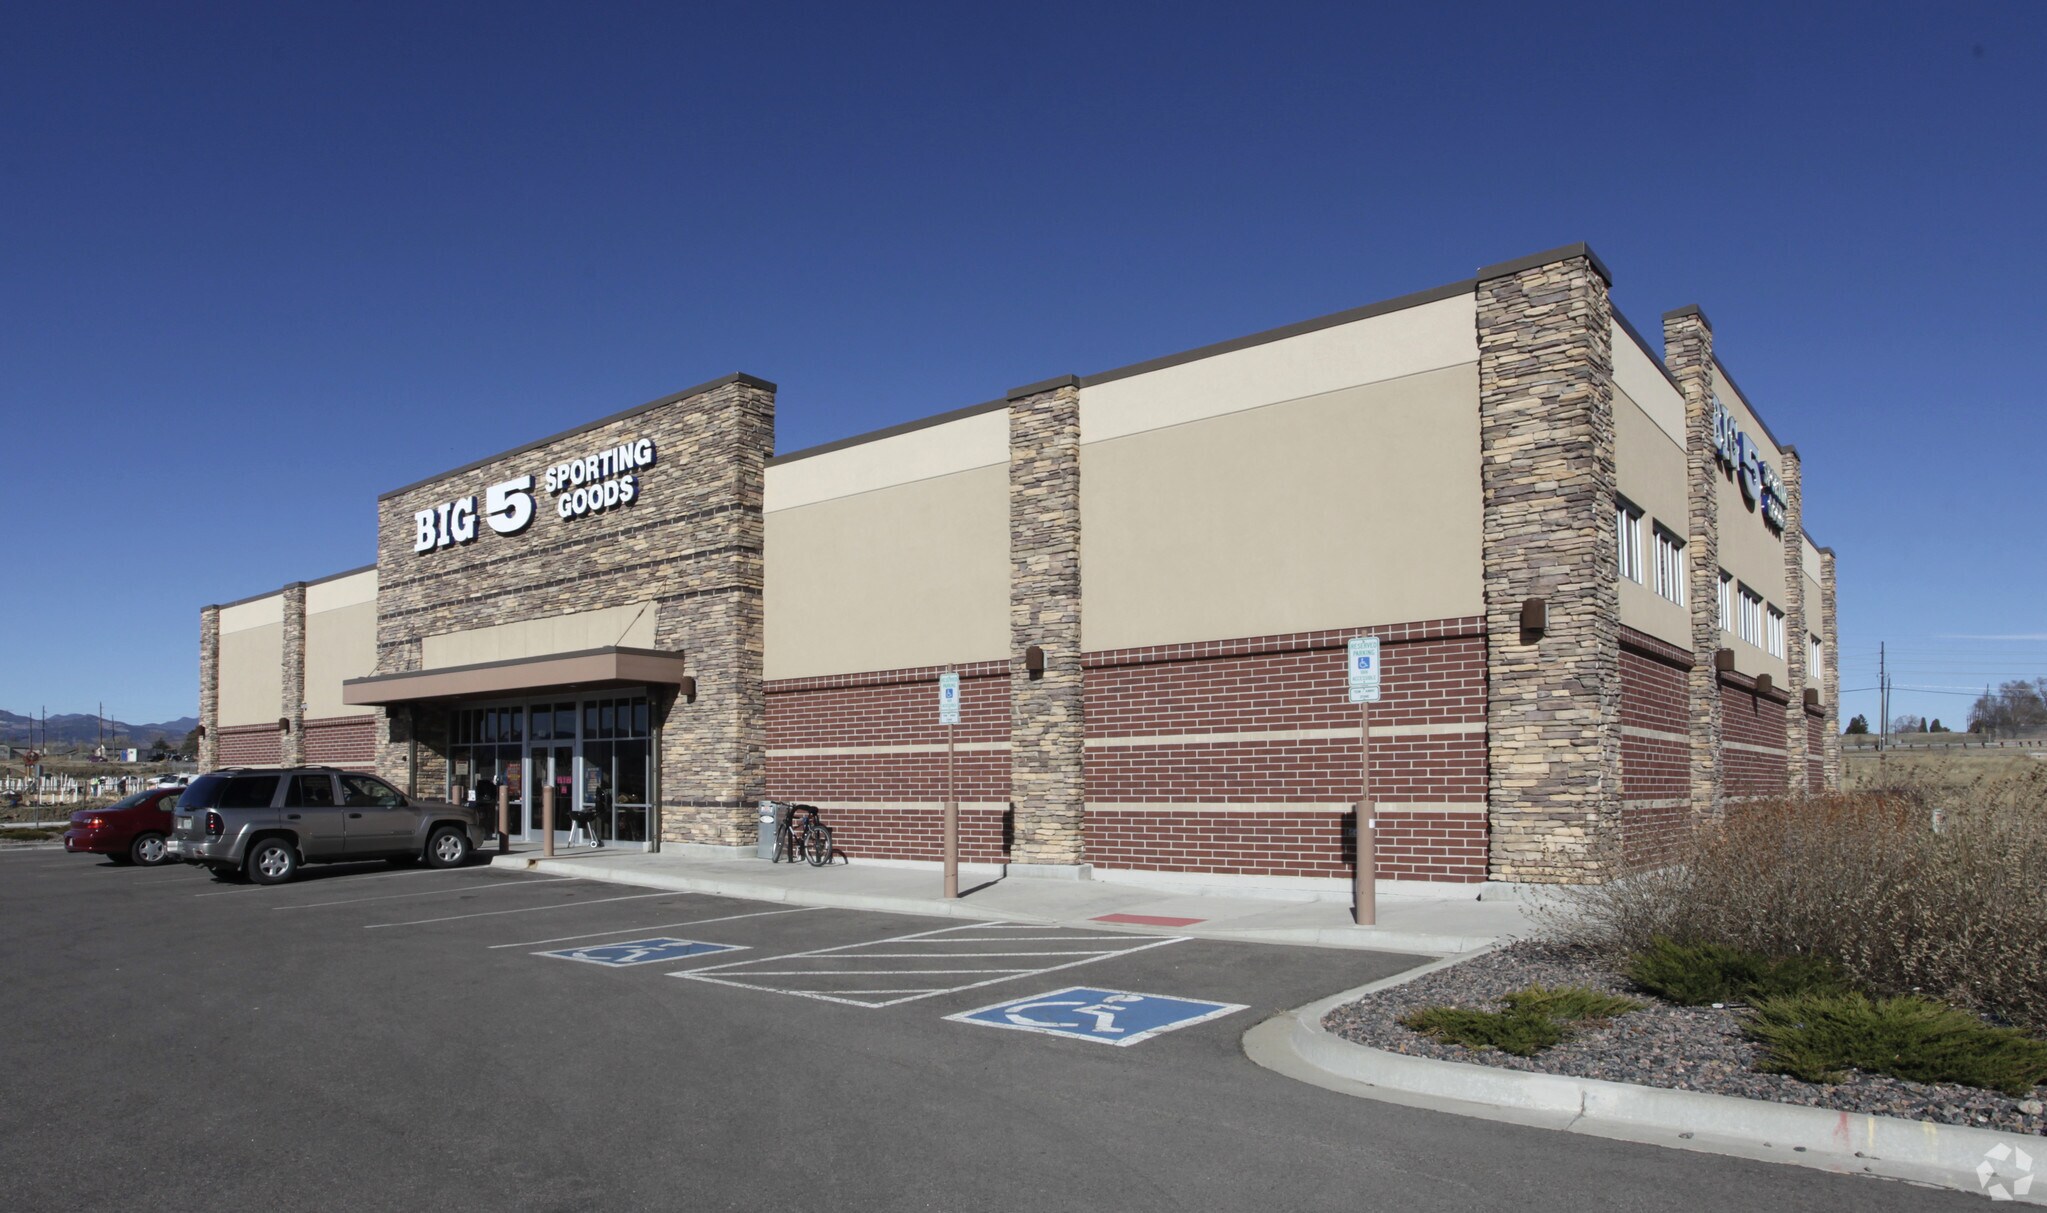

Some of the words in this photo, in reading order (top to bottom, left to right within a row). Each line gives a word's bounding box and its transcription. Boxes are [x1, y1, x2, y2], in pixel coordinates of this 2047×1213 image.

[545, 438, 653, 492] SPORTING
[1738, 431, 1760, 501] 5
[415, 498, 477, 552] BIG
[486, 475, 534, 533] 5
[558, 475, 634, 518] GOODS
